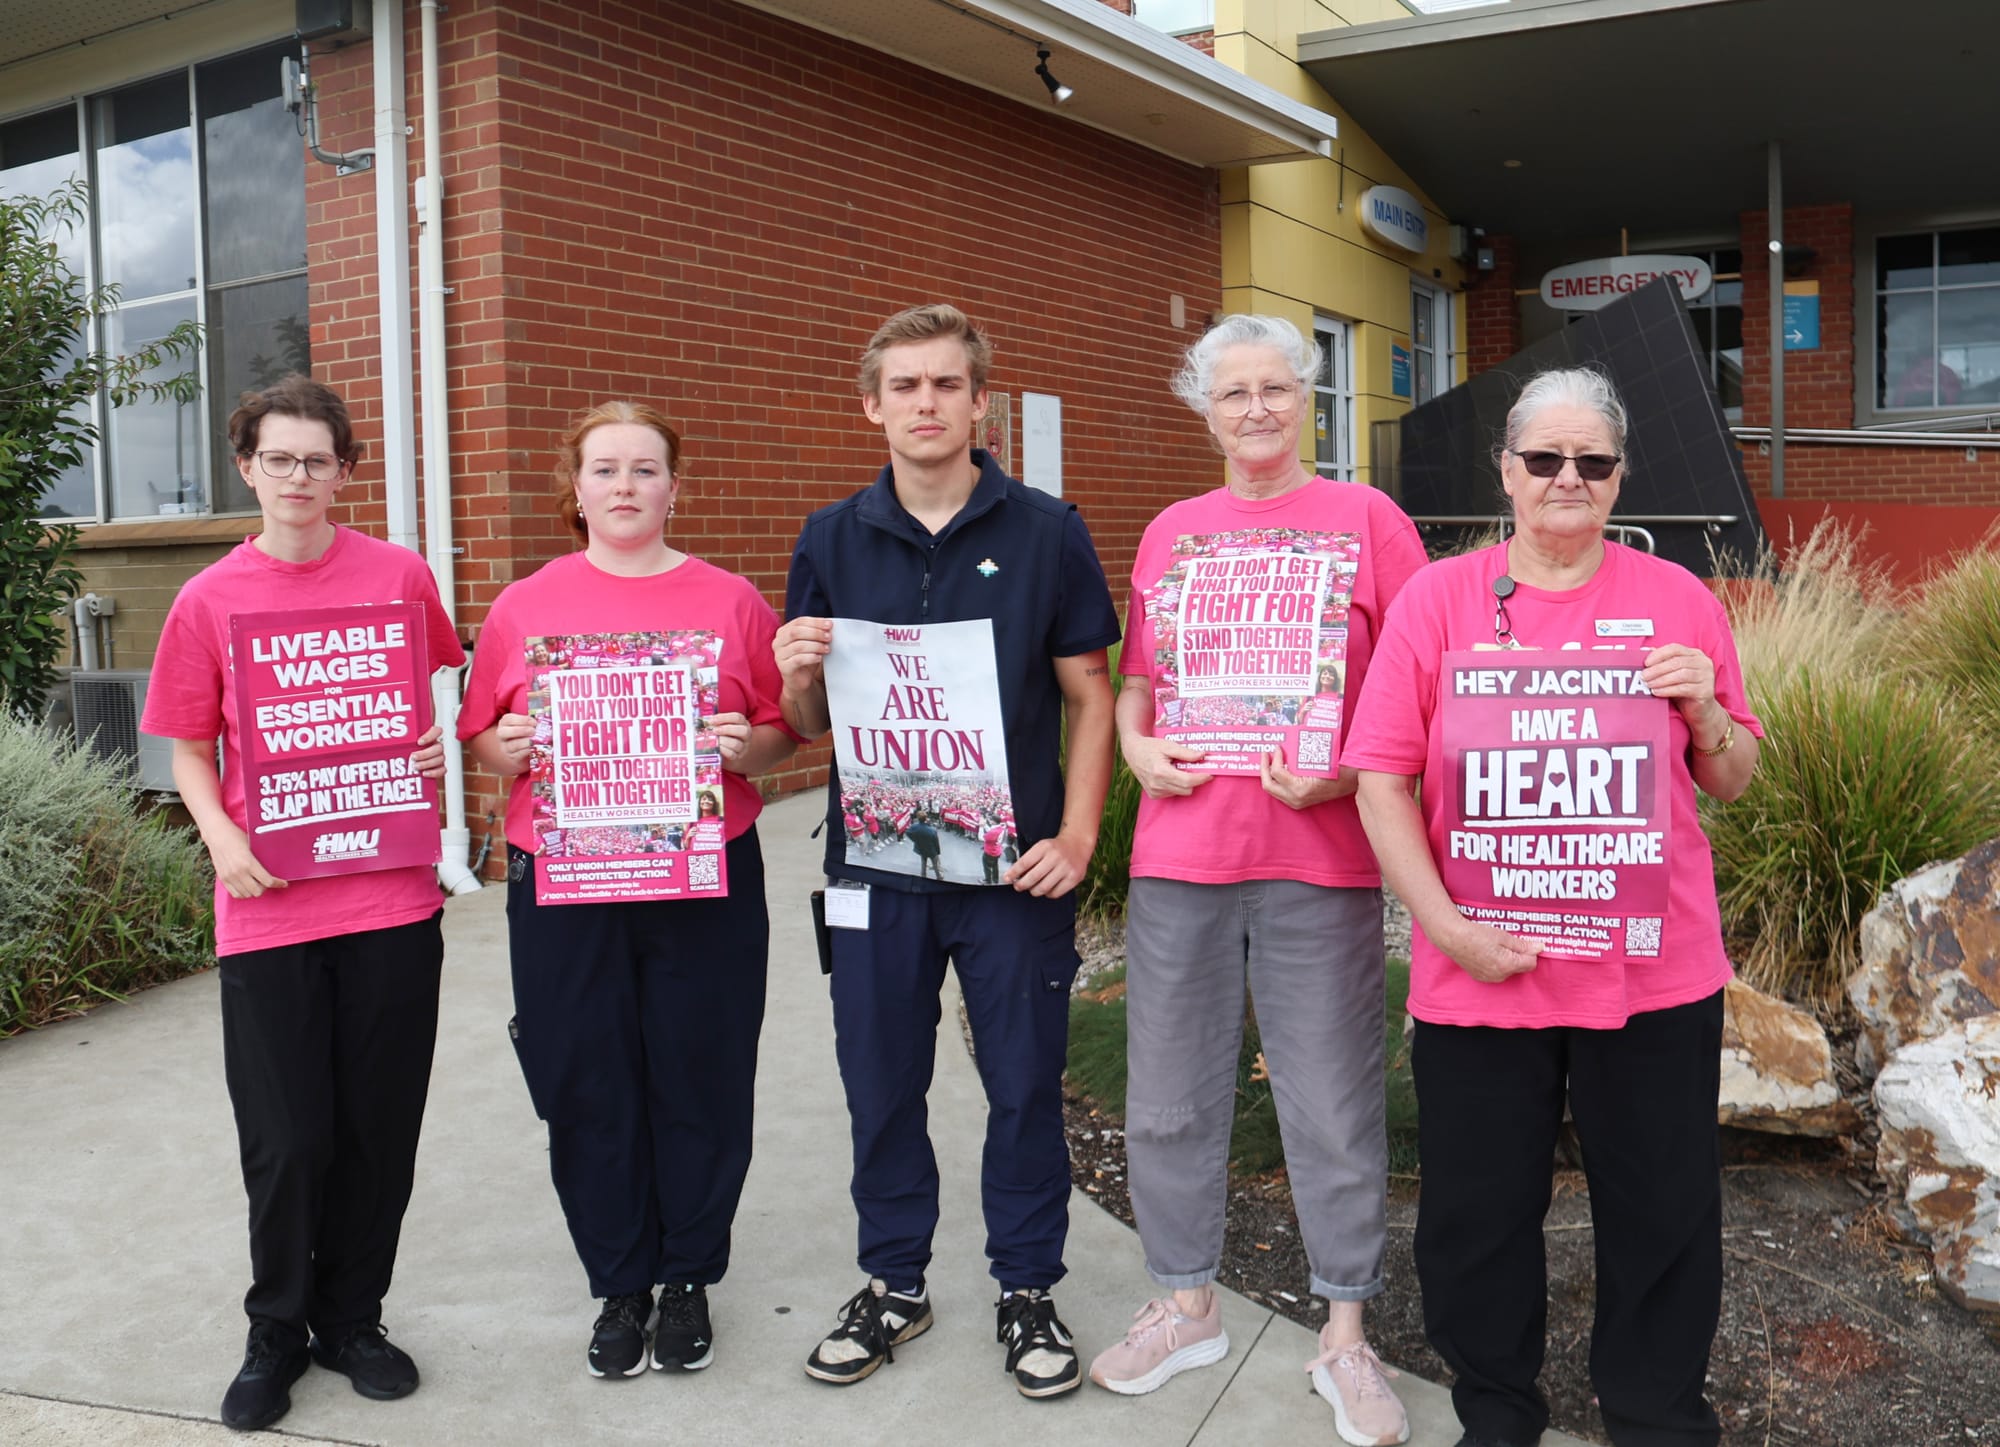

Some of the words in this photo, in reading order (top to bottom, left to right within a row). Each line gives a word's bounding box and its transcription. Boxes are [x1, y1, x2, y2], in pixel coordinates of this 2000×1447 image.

[1374, 198, 1403, 228] MAIN
[1195, 561, 1230, 577] YOU
[1232, 557, 1286, 576] DON'T
[1288, 557, 1324, 575] GET
[1190, 577, 1238, 592] WHAT
[1240, 576, 1270, 592] YOU
[1272, 575, 1320, 592] DON'T
[1184, 593, 1261, 624] FIGHT
[1264, 593, 1315, 623] FOR
[252, 623, 406, 663] LIVEABLE
[884, 628, 921, 641] HWU
[1183, 629, 1231, 651] STAND
[1234, 628, 1313, 650] TOGETHER
[272, 653, 389, 688] WAGES
[887, 652, 930, 681] WE
[1183, 651, 1220, 677] WIN
[1223, 649, 1312, 675] TOGETHER
[323, 686, 343, 696] FOR
[556, 674, 593, 700] YOU
[596, 671, 648, 698] DON'T
[652, 670, 685, 696] GET
[1185, 680, 1220, 689] HEALTH
[1223, 679, 1271, 687] WORKERS
[1456, 670, 1518, 695] HEY
[256, 690, 412, 729] ESSENTIAL
[558, 699, 605, 722] WHAT
[608, 697, 642, 720] YOU
[643, 695, 686, 718] DON'T
[879, 683, 949, 721] ARE
[262, 715, 408, 754] WORKERS
[560, 719, 633, 757] FIGHT
[639, 717, 687, 753] FOR
[1187, 732, 1215, 740] UNION
[1216, 732, 1262, 741] MEMBERS
[1263, 732, 1285, 741] CAN
[1511, 708, 1576, 742] HAVE
[1580, 707, 1599, 740] A
[848, 725, 985, 771] UNION
[259, 771, 308, 796] 3.75%
[309, 766, 339, 789] PAY
[339, 759, 388, 785] OFFER
[389, 757, 406, 778] IS
[407, 757, 420, 776] A
[561, 760, 610, 783] STAND
[613, 756, 689, 781] TOGETHER
[1465, 746, 1648, 817] HEART
[260, 793, 309, 822] SLAP
[311, 789, 332, 814] IN
[332, 784, 371, 810] THE
[372, 777, 423, 805] FACE!
[562, 783, 600, 808] WIN
[602, 778, 691, 806] TOGETHER
[564, 810, 602, 820] HEALTH
[605, 808, 655, 817] WORKERS
[312, 828, 381, 855] HWU
[1450, 830, 1497, 862] FOR
[1501, 832, 1664, 866] HEALTHCARE
[546, 863, 572, 873] ONLY
[573, 862, 604, 871] UNION
[605, 859, 652, 870] MEMBERS
[652, 858, 673, 868] CAN
[549, 873, 575, 883] TAKE
[575, 871, 632, 881] PROTECTED
[632, 869, 671, 879] ACTION.
[1491, 866, 1617, 901] WORKERS
[1456, 904, 1476, 917] NLY
[1477, 908, 1505, 919] HWU
[1507, 910, 1561, 922] MEMBERS
[1563, 914, 1588, 926] CAN
[1590, 916, 1621, 928] TAKE
[1522, 923, 1562, 935] STRIKE
[1563, 926, 1610, 940] ACTION.
